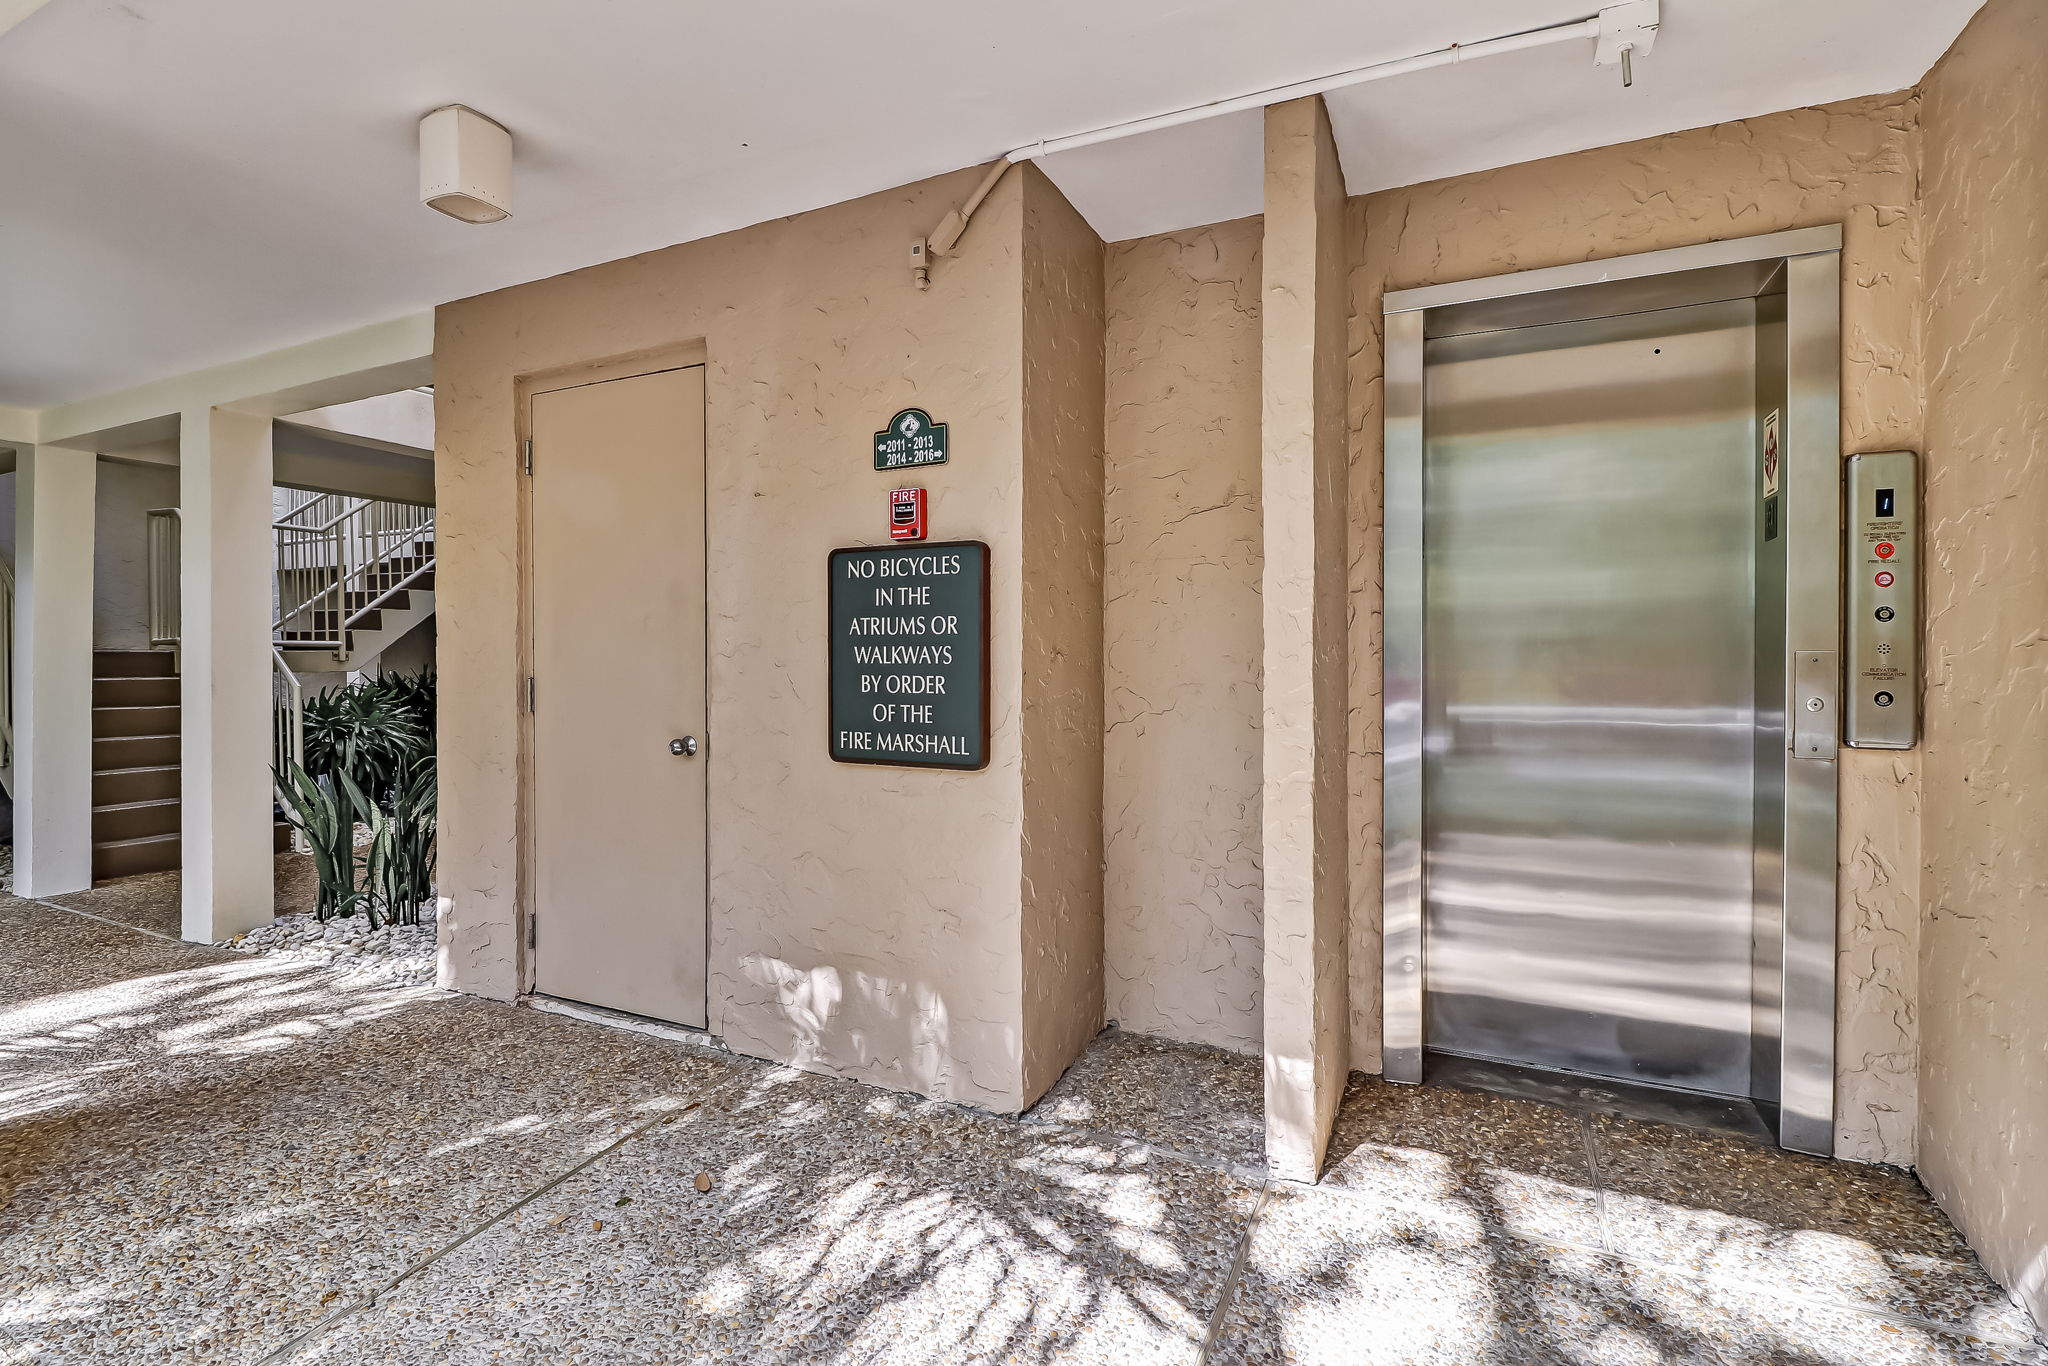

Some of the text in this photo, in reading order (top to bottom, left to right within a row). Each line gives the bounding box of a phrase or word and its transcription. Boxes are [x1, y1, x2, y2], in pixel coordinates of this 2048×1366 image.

[886, 439, 906, 452] 2011
[913, 434, 934, 450] 2013
[887, 452, 906, 466] 2014
[914, 448, 934, 463] 2016
[892, 490, 916, 502] FIRE
[848, 555, 960, 578] NO BICYCLES
[876, 586, 930, 606] IN THE
[849, 615, 958, 636] ATRIUMS OR
[854, 646, 952, 664] WALKWAYS
[862, 674, 946, 694] BY ORDER
[873, 704, 933, 724] OF THE
[840, 732, 970, 756] FIRE MARSHALL
